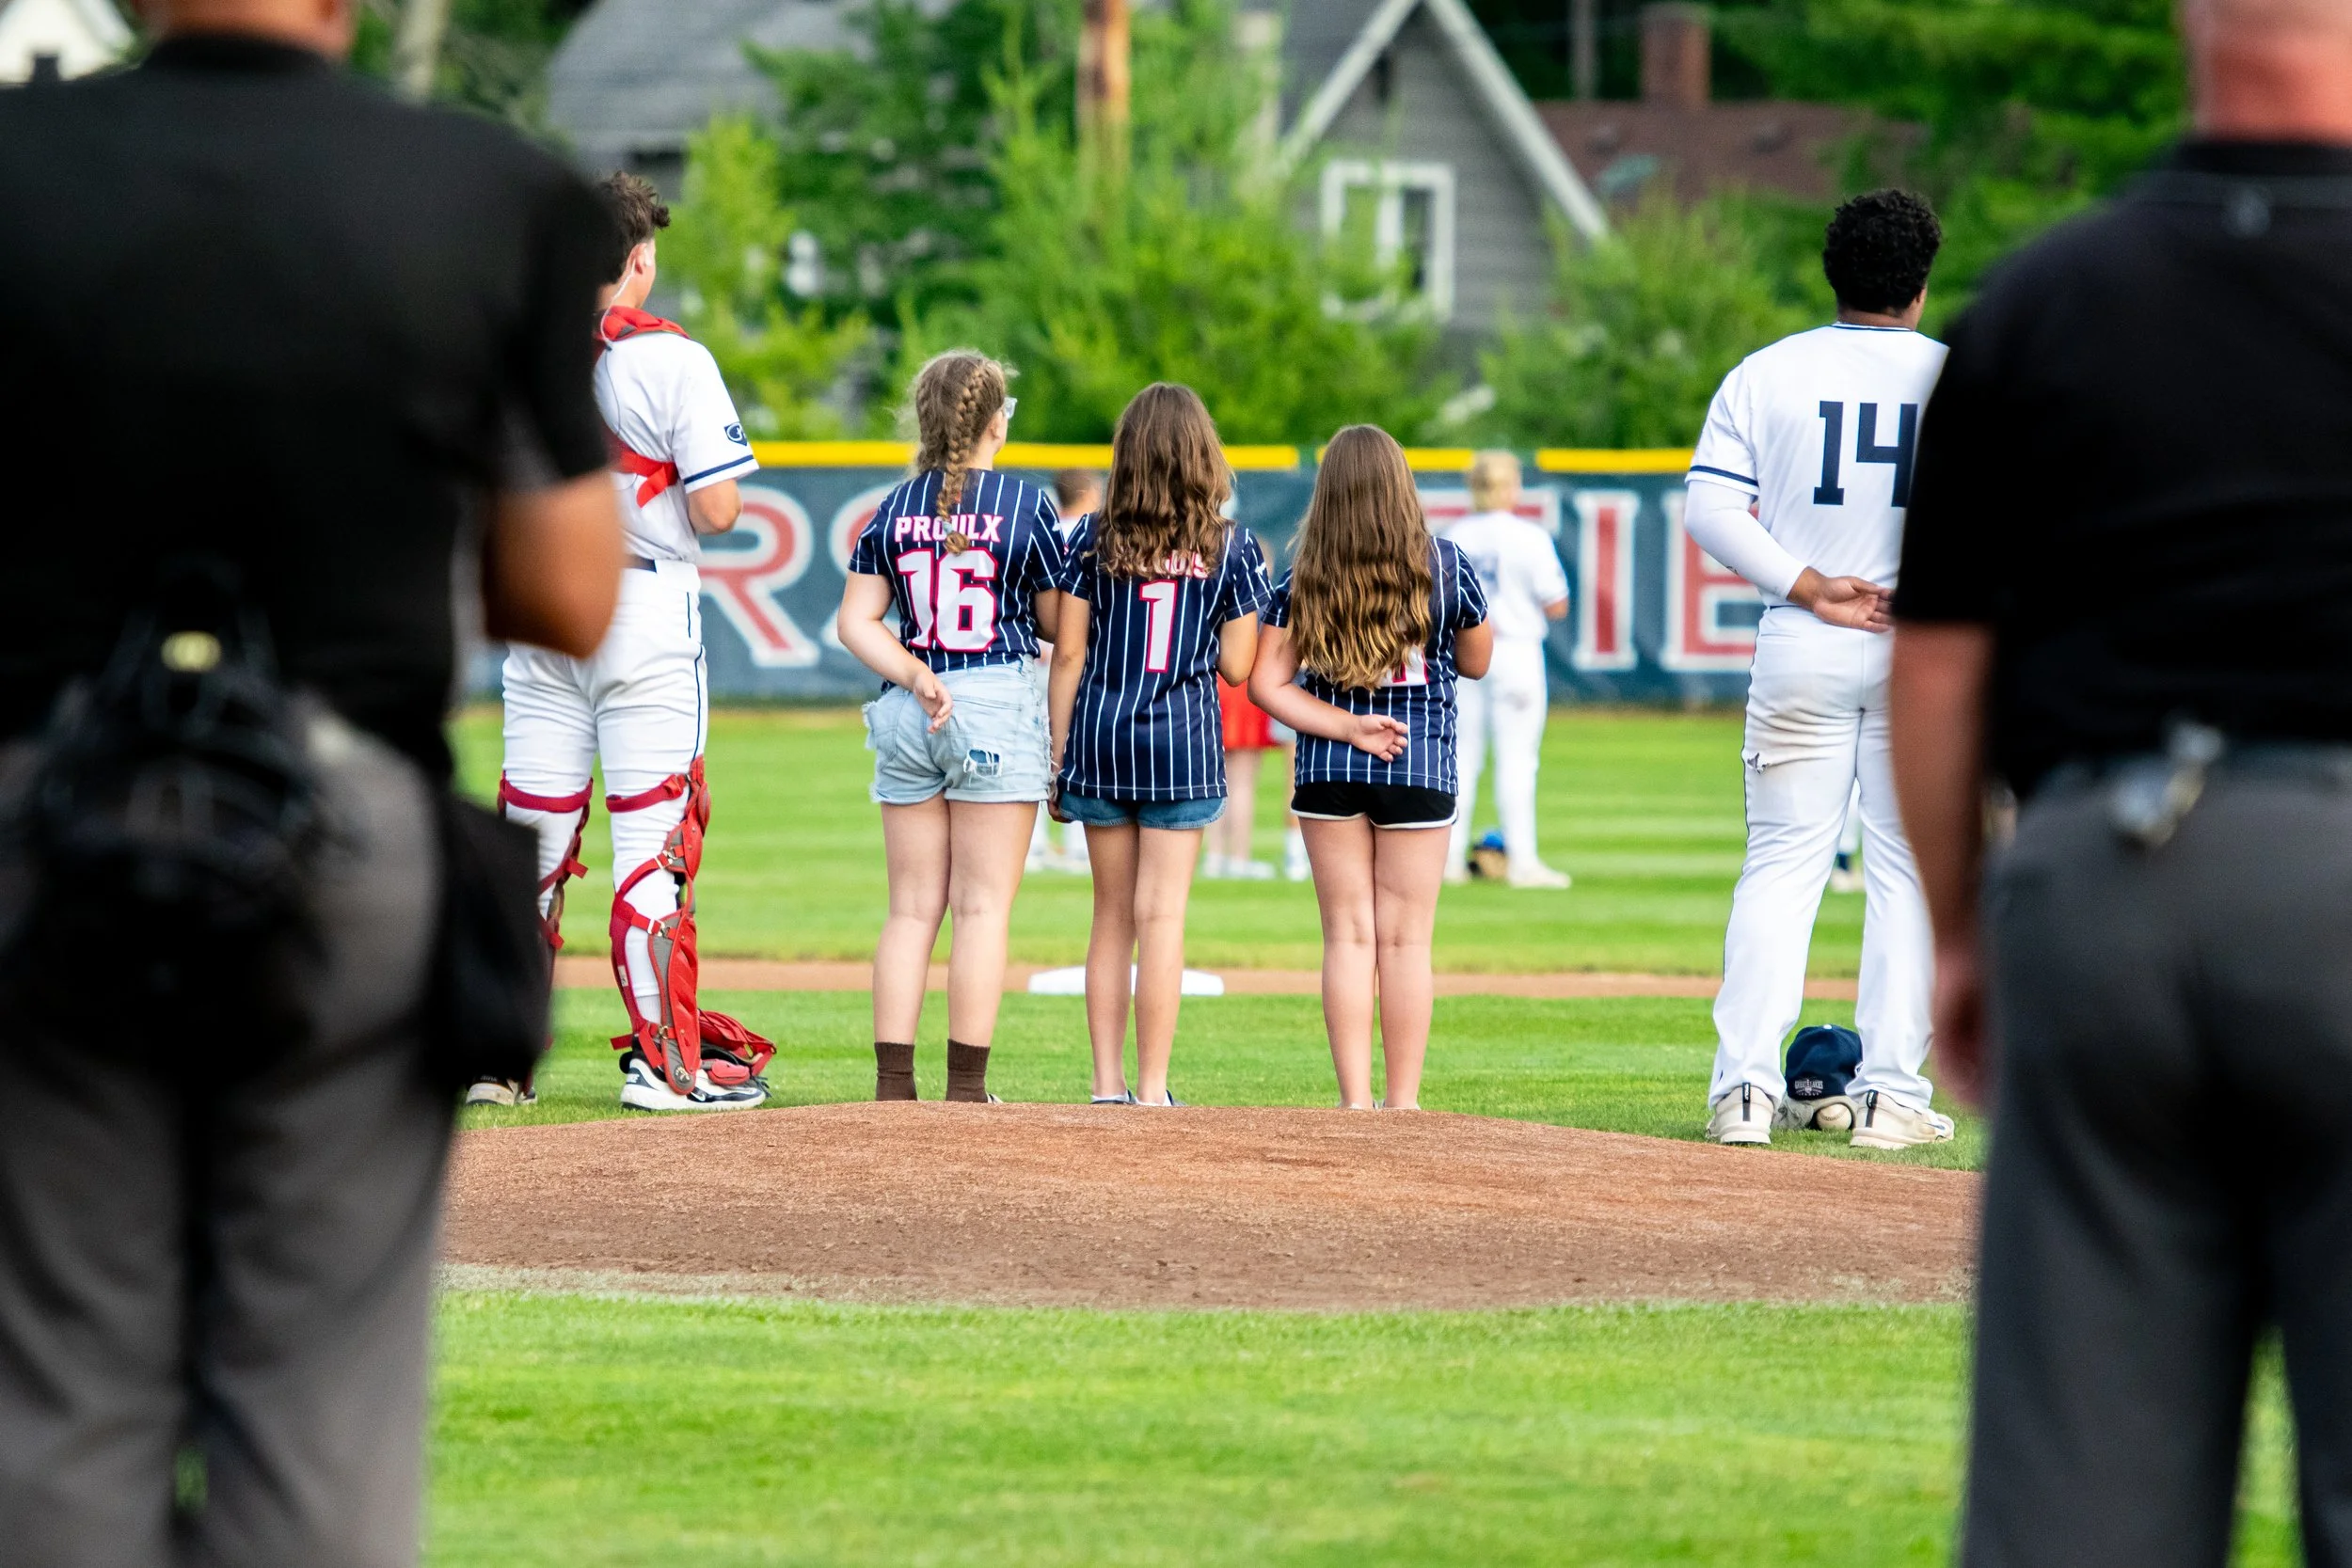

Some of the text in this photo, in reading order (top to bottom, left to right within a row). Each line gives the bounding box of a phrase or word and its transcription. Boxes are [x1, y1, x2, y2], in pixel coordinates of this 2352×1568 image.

[1813, 400, 1919, 508] 14
[895, 514, 1004, 543] PROULX
[896, 546, 998, 653] 16
[1139, 579, 1178, 673] 1
